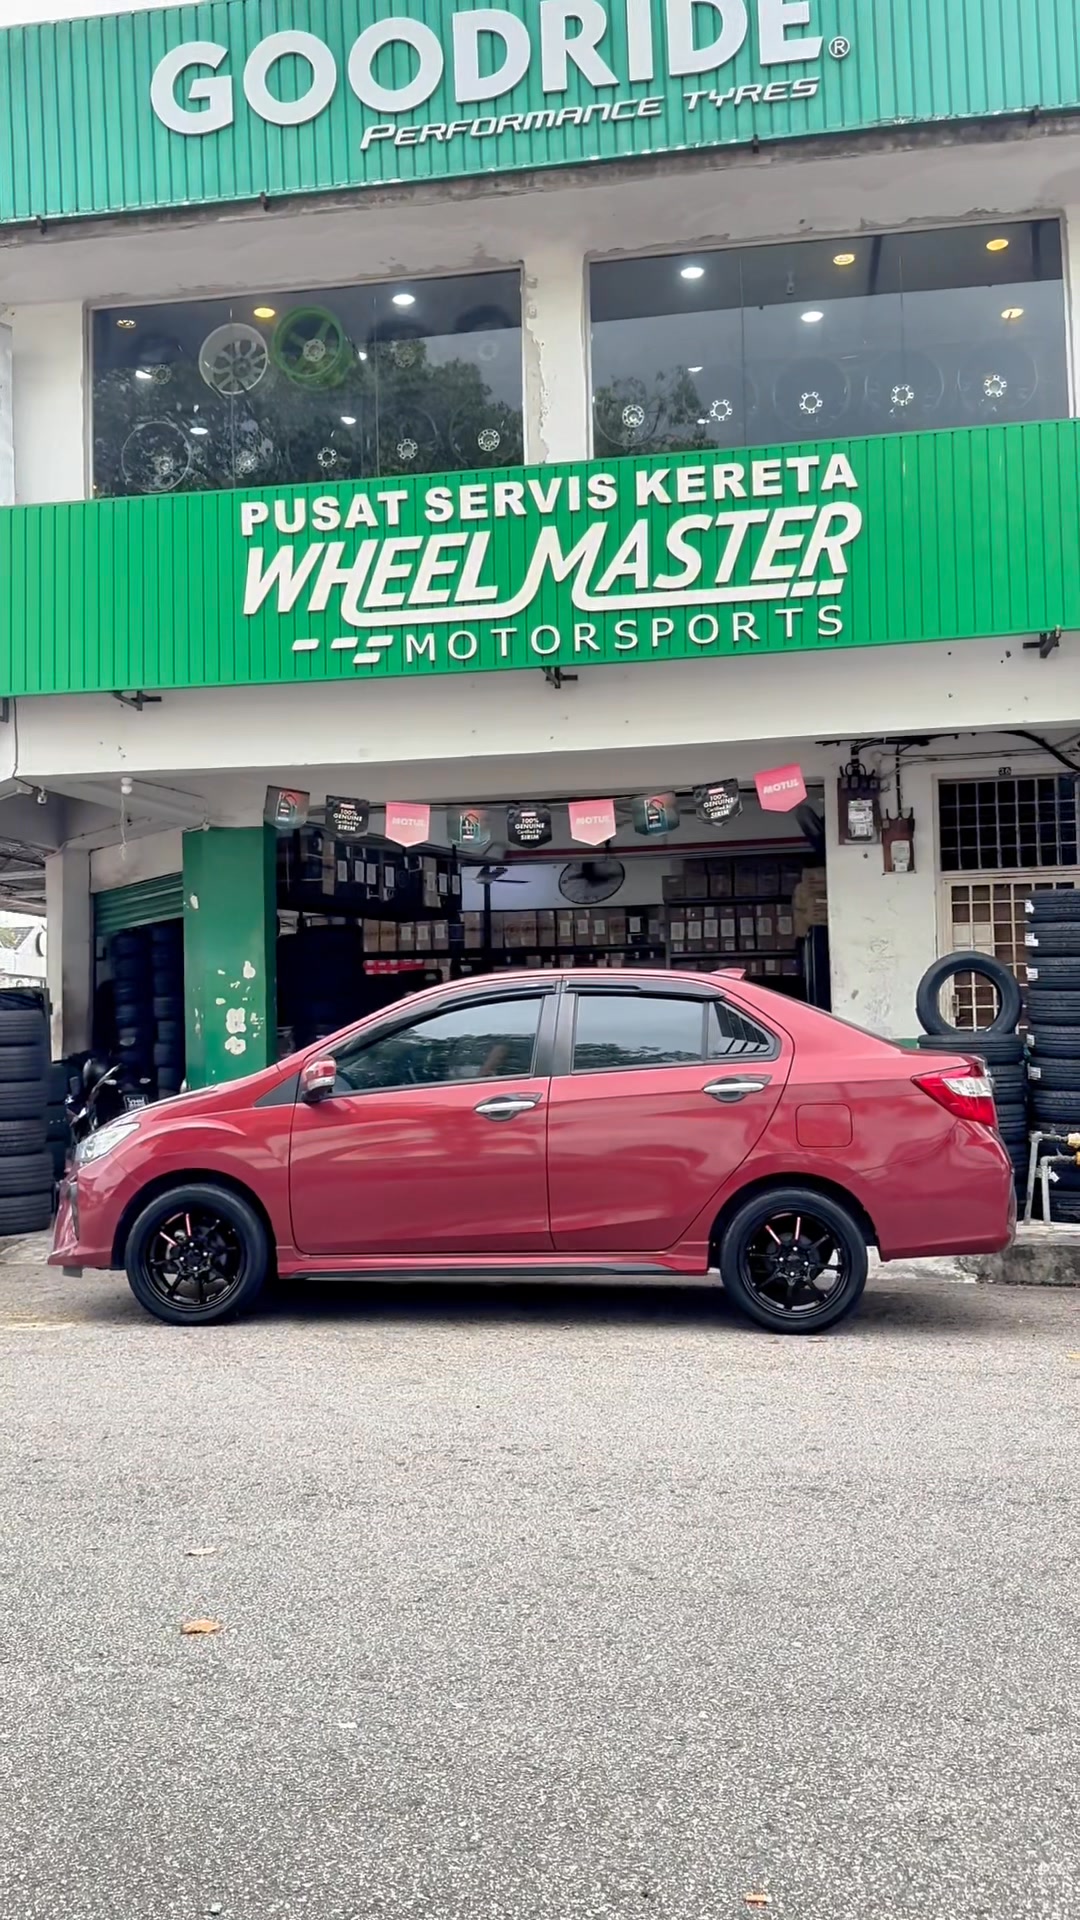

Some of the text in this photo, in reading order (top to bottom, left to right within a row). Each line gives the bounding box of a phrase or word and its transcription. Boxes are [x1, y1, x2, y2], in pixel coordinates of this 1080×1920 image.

[150, 0, 824, 135] GOODRIDE
[360, 77, 819, 150] PERFORMANCE TYRES
[241, 453, 859, 536] PUSAT SERVIS KERETA
[243, 501, 862, 627] WHEEL MASTER
[405, 605, 844, 662] MOTORSPORTS
